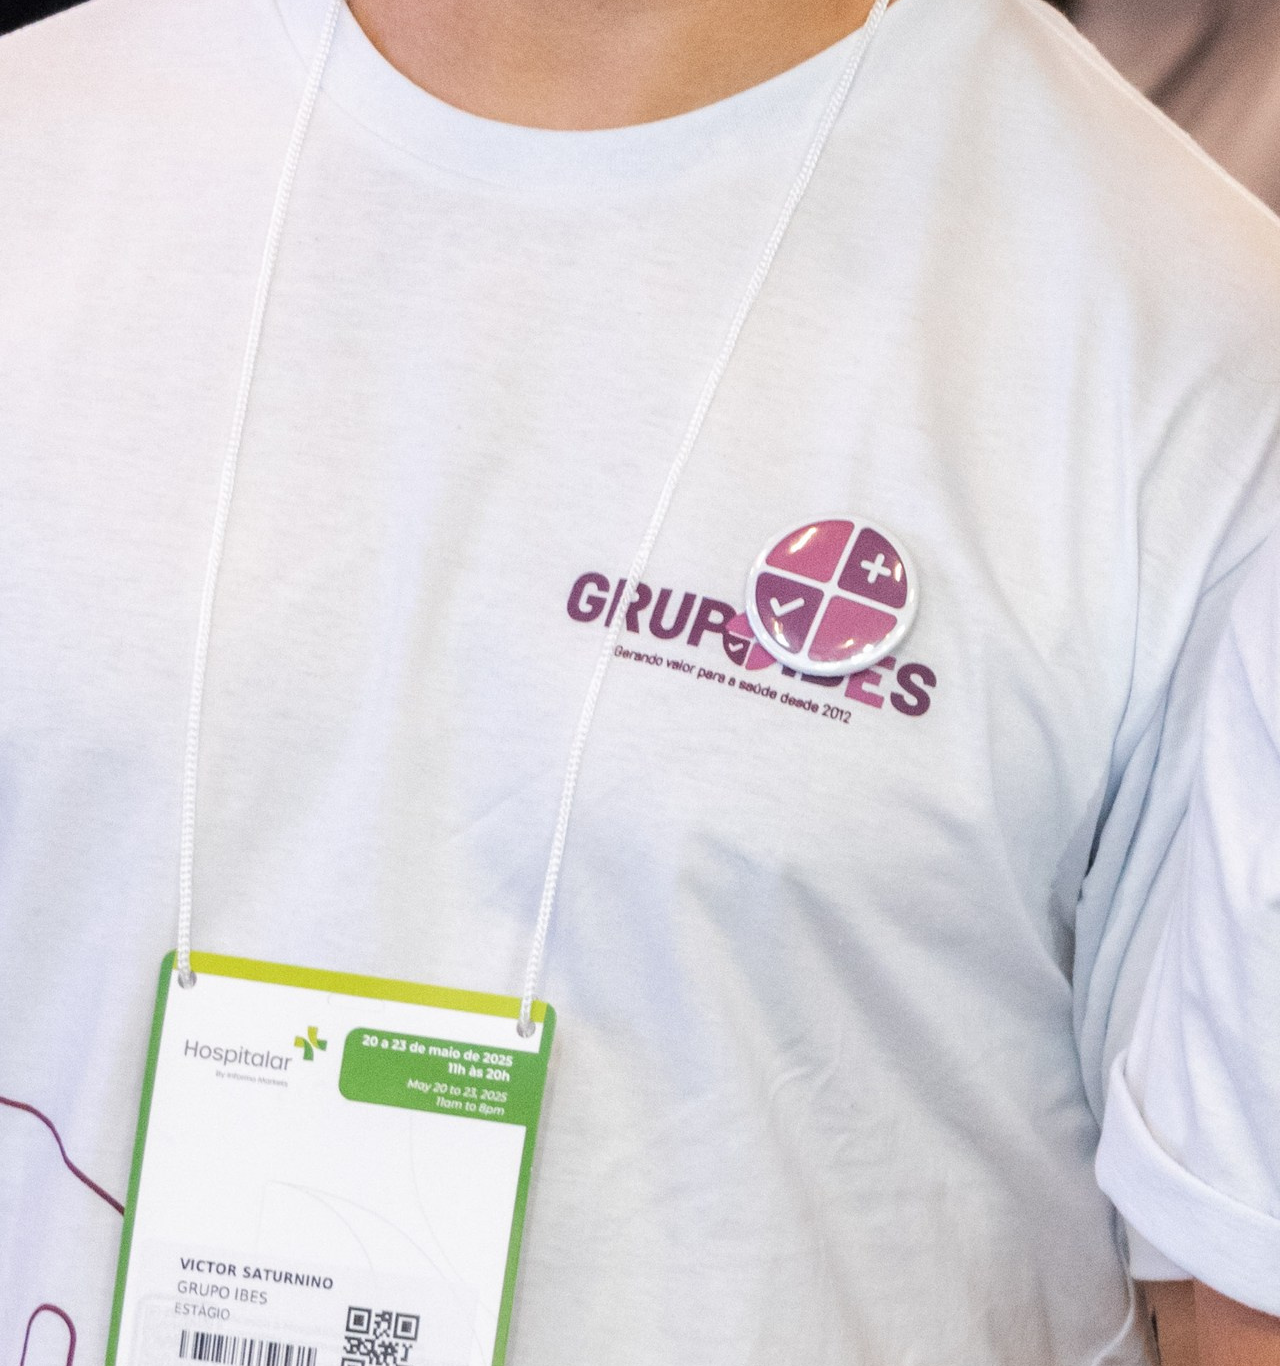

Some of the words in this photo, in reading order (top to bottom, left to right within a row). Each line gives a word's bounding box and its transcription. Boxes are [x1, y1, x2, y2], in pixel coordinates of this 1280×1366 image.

[614, 644, 664, 667] Gerando
[666, 658, 695, 674] valor
[697, 666, 727, 685] para
[728, 677, 736, 687] a
[738, 678, 778, 700] saúde
[780, 693, 820, 714] desde
[822, 704, 853, 724] 2012
[184, 1039, 293, 1071] Hospitalar
[362, 1034, 379, 1047] 20
[381, 1038, 389, 1049] a
[391, 1038, 407, 1052] 23
[409, 1041, 426, 1054] de
[429, 1045, 461, 1059] maio
[464, 1049, 480, 1062] de
[482, 1052, 513, 1067] 2025
[448, 1062, 466, 1076] 11h
[469, 1065, 483, 1079] às
[485, 1067, 511, 1082] 20h
[407, 1078, 432, 1094] May
[433, 1081, 448, 1093] 20
[450, 1084, 462, 1096] to
[480, 1088, 508, 1103] 2025
[436, 1095, 463, 1110] 11am
[465, 1101, 477, 1112] to
[478, 1102, 505, 1116] 8pm
[180, 1257, 237, 1277] VICTOR
[242, 1266, 334, 1290] SATURNINO
[177, 1280, 231, 1300] GRUPO
[234, 1287, 268, 1305] IBES
[174, 1301, 231, 1321] ESTÁGIO
